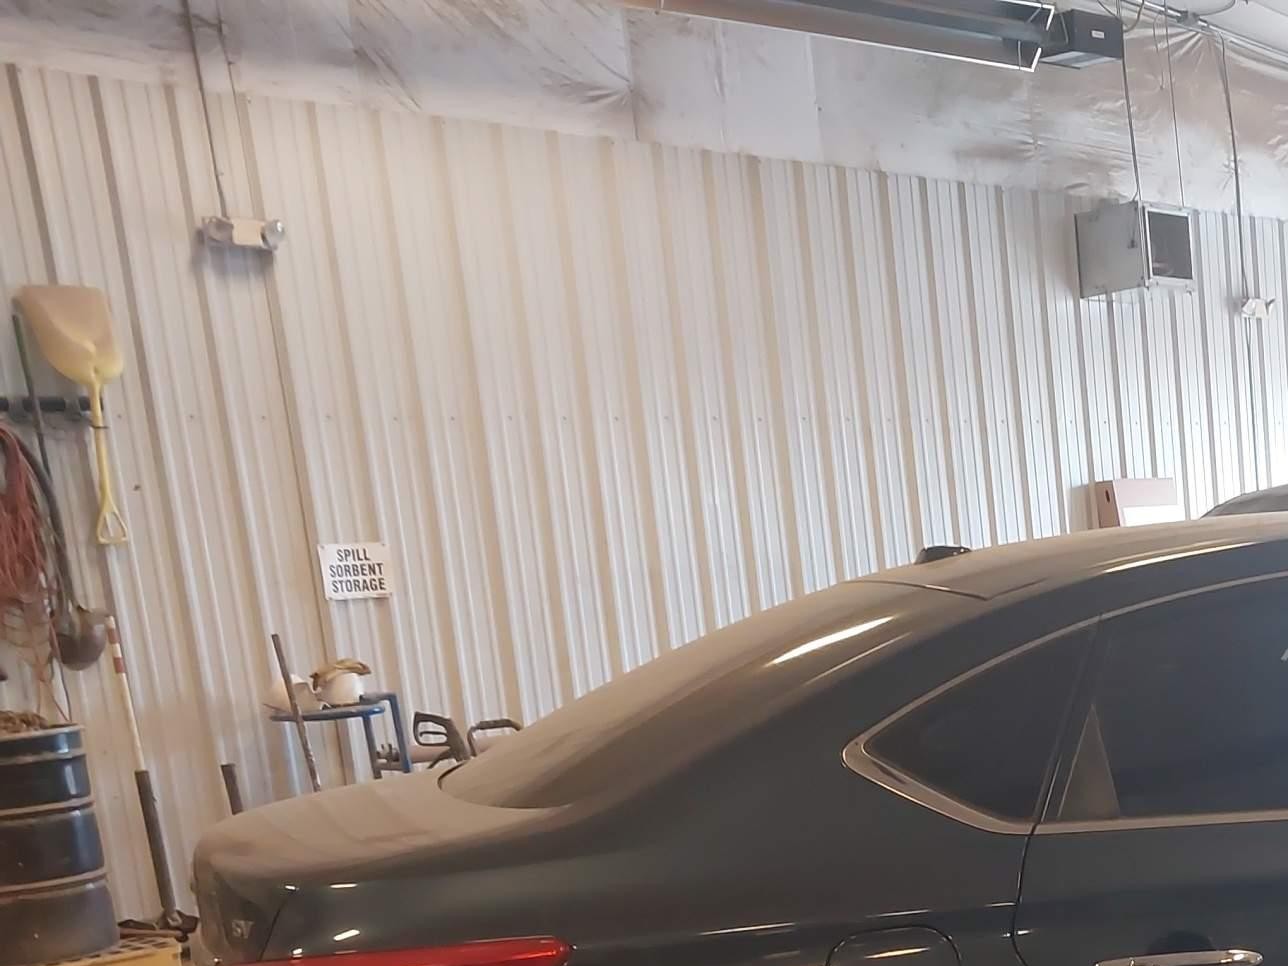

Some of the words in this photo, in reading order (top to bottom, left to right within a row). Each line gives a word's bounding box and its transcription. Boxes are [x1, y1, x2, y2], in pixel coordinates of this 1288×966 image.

[336, 548, 371, 562] SPILL
[329, 563, 384, 578] SORBENT
[331, 578, 387, 593] STORAGE
